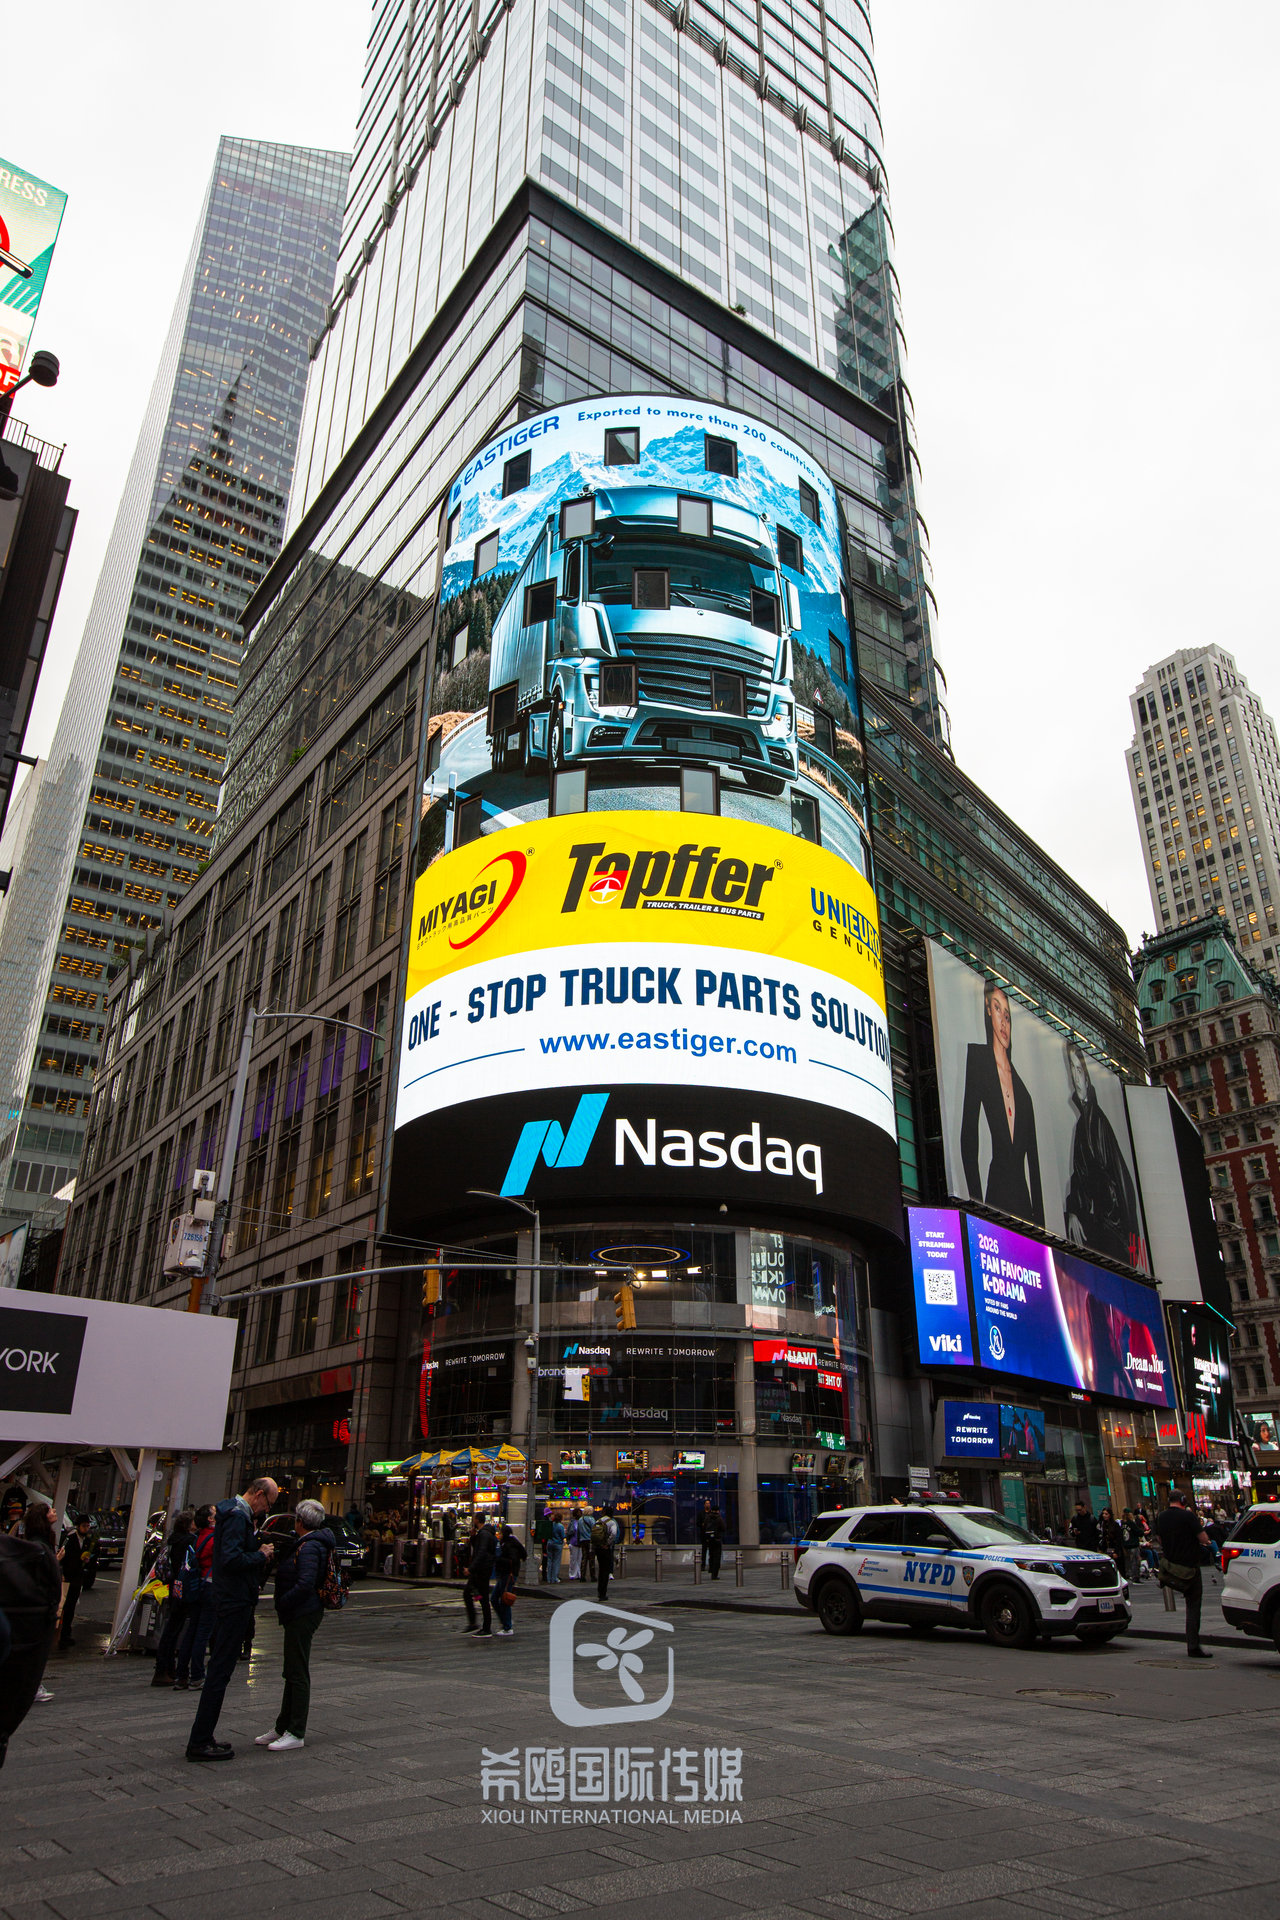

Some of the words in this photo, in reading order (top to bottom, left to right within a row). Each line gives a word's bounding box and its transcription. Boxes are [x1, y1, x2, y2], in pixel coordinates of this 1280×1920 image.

[464, 416, 560, 486] EASTIGER
[578, 406, 641, 421] Exported
[647, 407, 661, 416] to
[667, 411, 703, 421] more
[708, 415, 739, 431] than
[743, 425, 767, 442] 200
[770, 441, 815, 478] countries
[418, 880, 497, 941] MIYAGI
[646, 901, 677, 910] TRUCK,
[678, 902, 712, 912] TRAILER
[720, 907, 736, 915] BUS
[737, 909, 762, 919] PARTS
[408, 1000, 441, 1051] ONE
[467, 973, 546, 1024] STOP
[560, 966, 682, 1007] TRUCK
[695, 968, 801, 1021] PARTS
[539, 1028, 797, 1064] www.eastiger.com
[615, 1118, 825, 1197] Nasdaq
[918, 1240, 955, 1249] STREAMING
[925, 1231, 945, 1239] START
[977, 1233, 999, 1254] 2026
[926, 1250, 949, 1259] TODAY
[980, 1252, 1000, 1274] FAN
[1000, 1259, 1042, 1289] FAVORITE
[982, 1273, 1027, 1303] K-DRAMA
[445, 1356, 467, 1367] REWRITE
[469, 1352, 506, 1363] TOMORROW
[579, 1346, 611, 1356] Nasdaq
[626, 1347, 664, 1355] REWRITE
[668, 1347, 717, 1357] TOMORROW
[1124, 1352, 1148, 1372] Dream
[1151, 1354, 1166, 1374] You
[623, 1406, 669, 1421] Nasdaq
[951, 1436, 994, 1444] TOMORROW
[956, 1426, 988, 1434] REWRITE
[984, 1554, 1006, 1562] POLICE
[903, 1560, 956, 1586] NYPD
